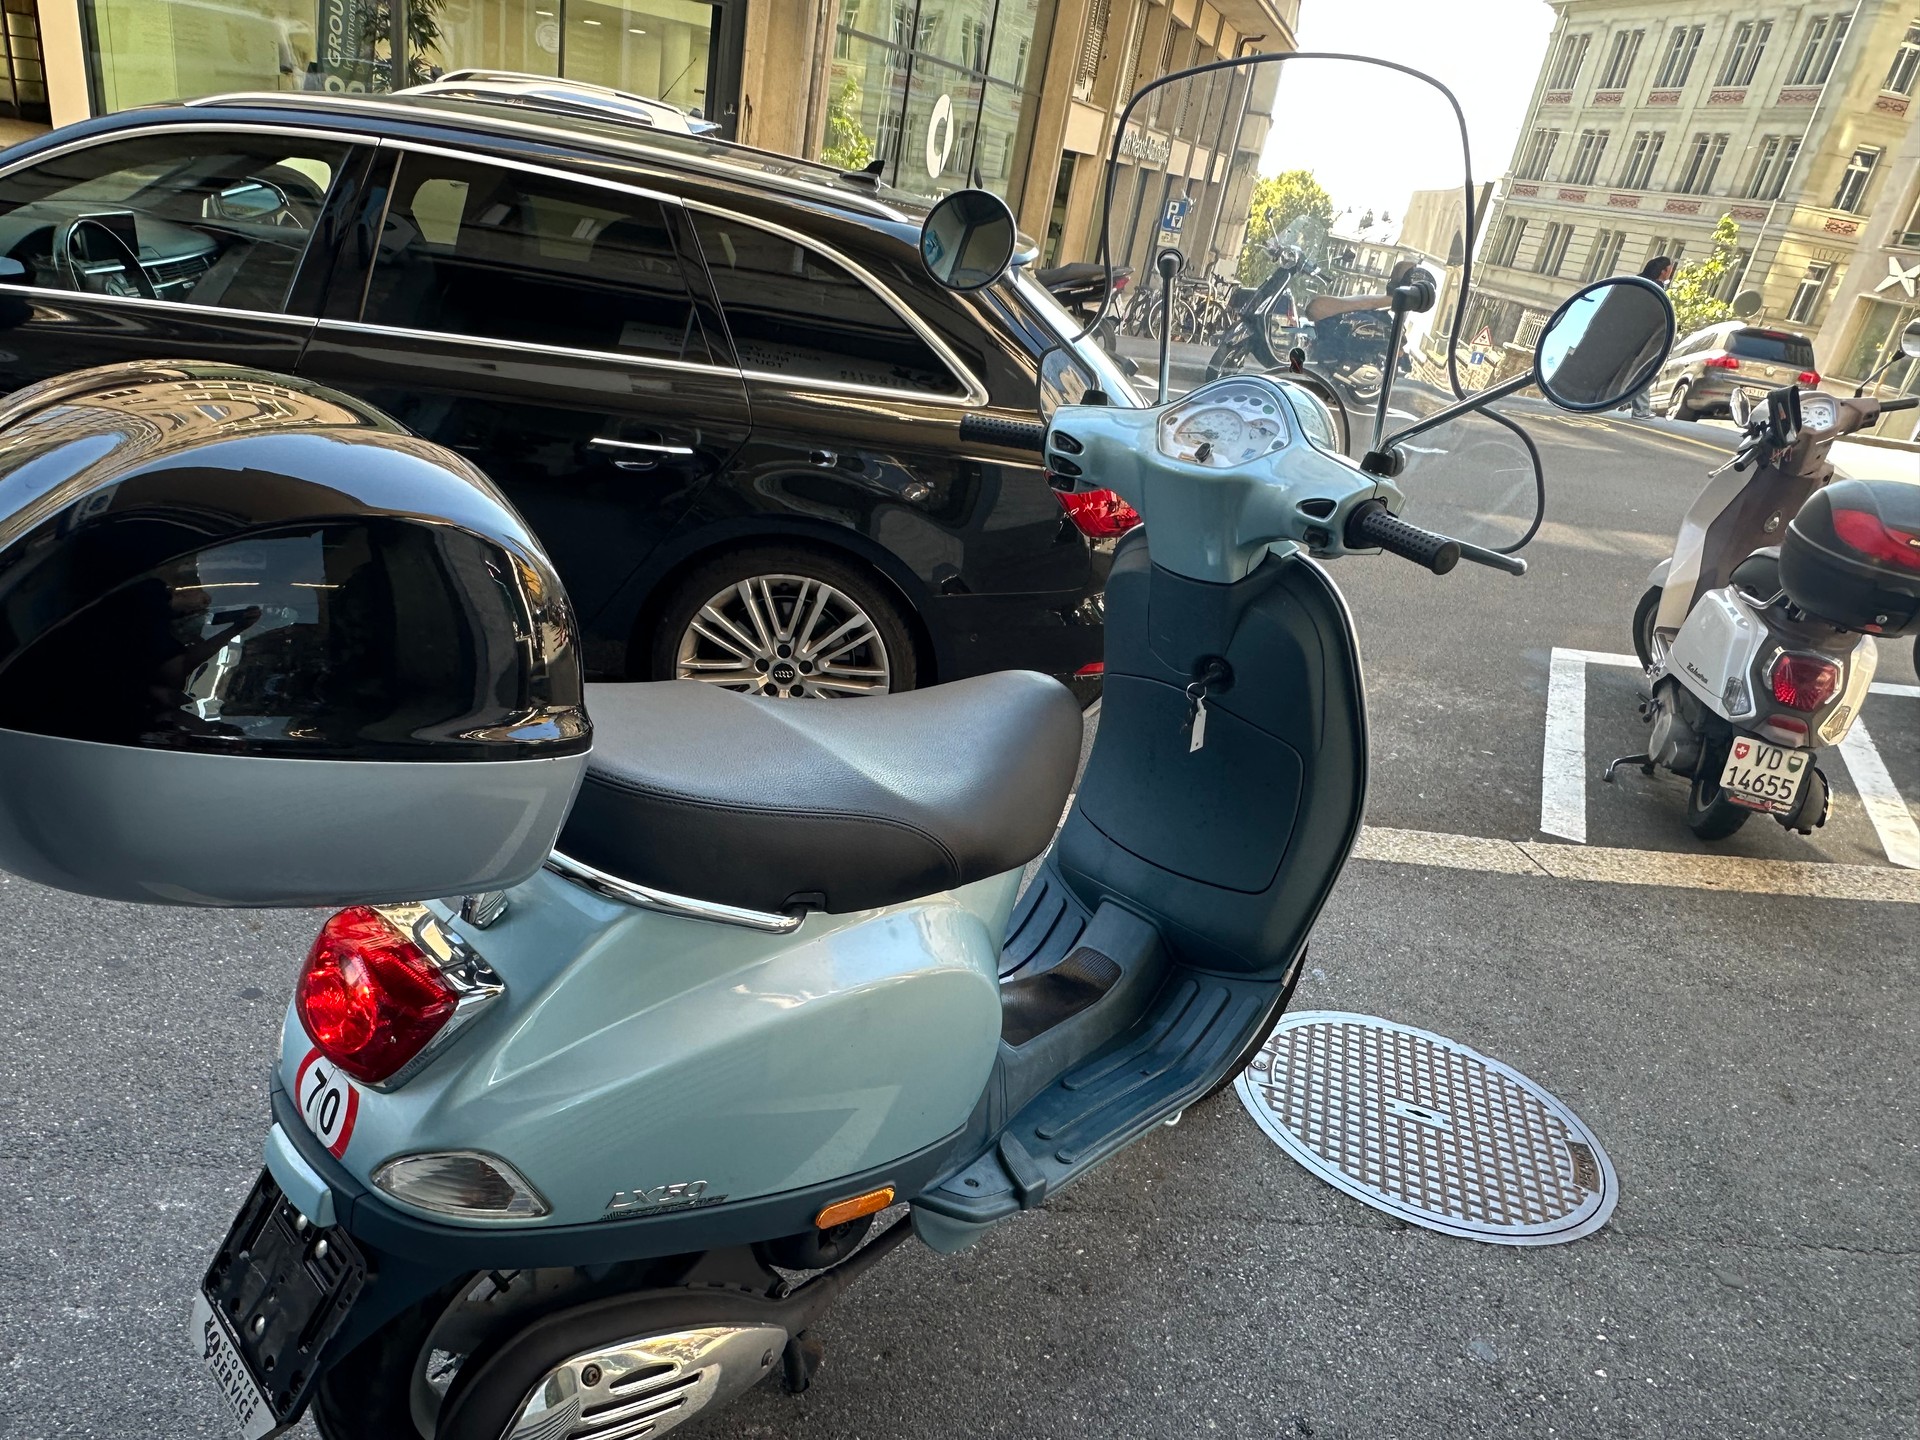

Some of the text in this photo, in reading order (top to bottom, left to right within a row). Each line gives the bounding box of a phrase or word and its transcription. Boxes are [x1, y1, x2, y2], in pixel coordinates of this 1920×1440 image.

[1167, 201, 1180, 220] P
[1755, 745, 1783, 770] VD
[1727, 766, 1794, 800] 14655
[306, 1067, 341, 1134] 70
[214, 1353, 254, 1424] SERVICE
[222, 1341, 259, 1409] SCOOTER
